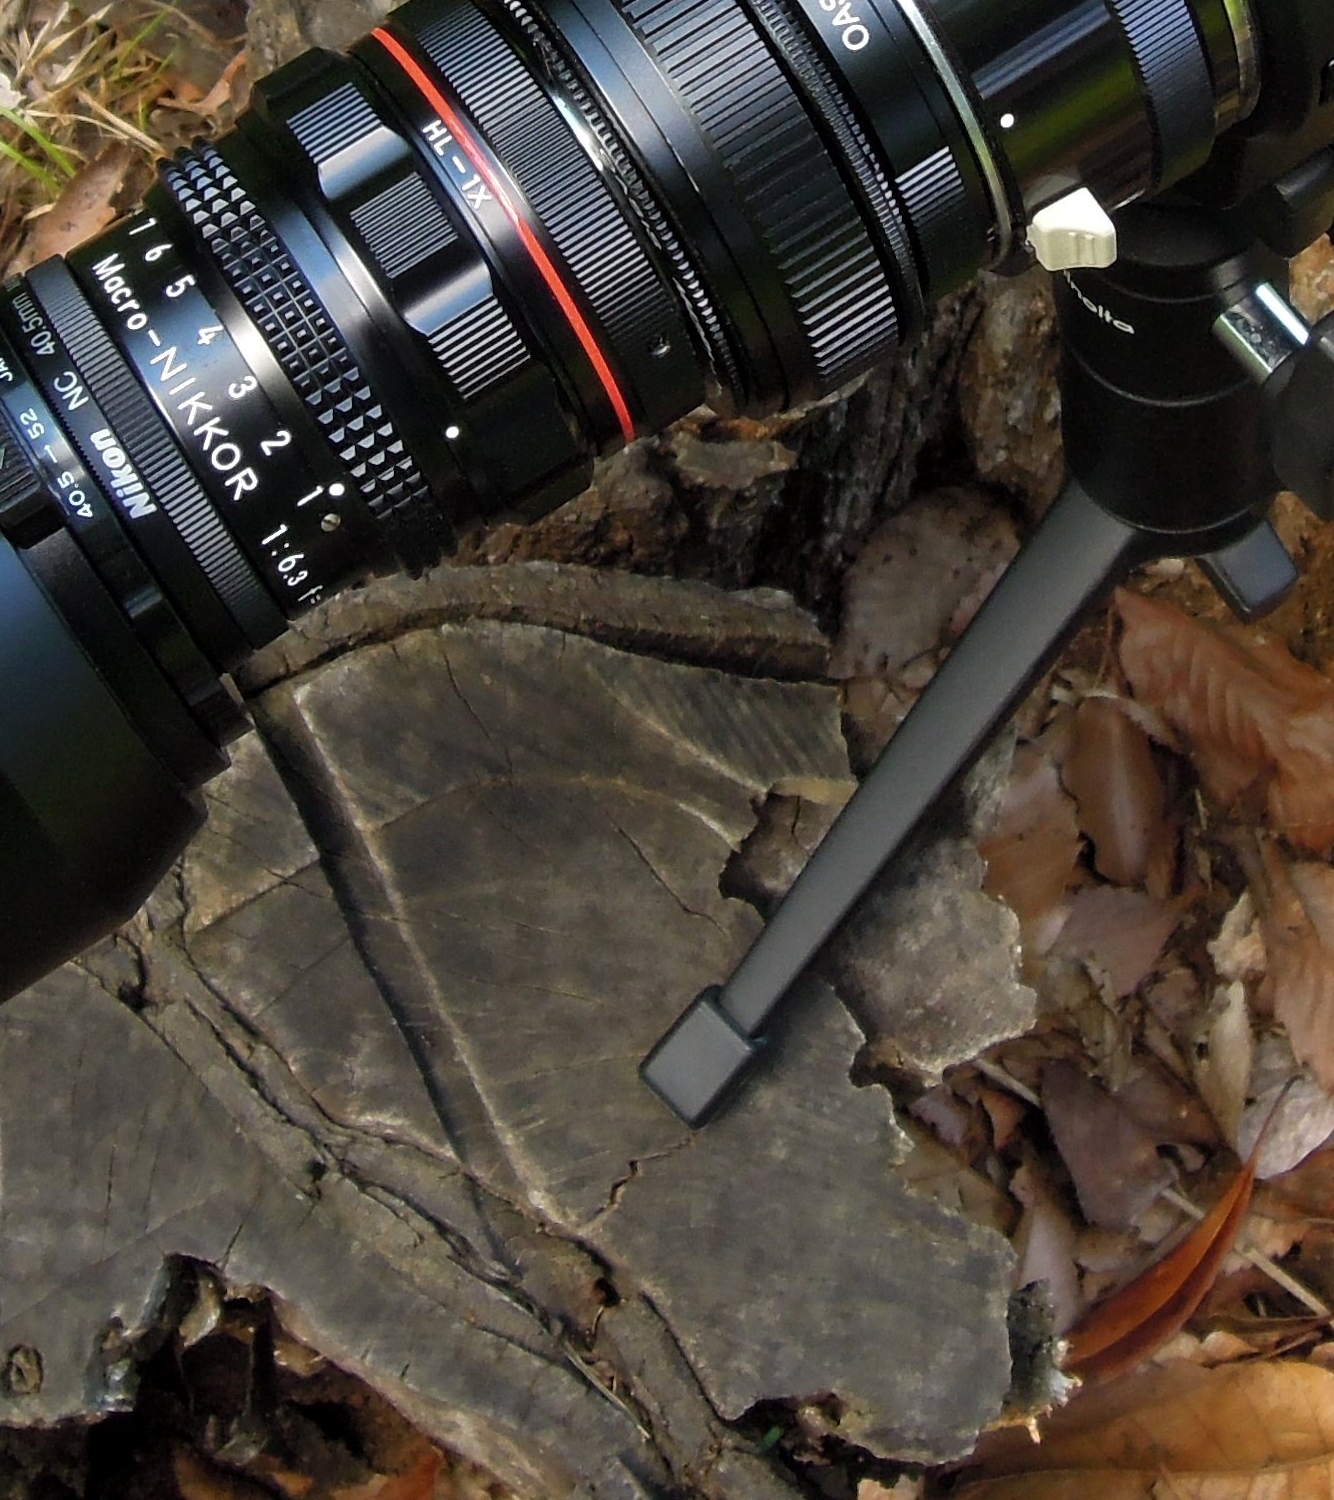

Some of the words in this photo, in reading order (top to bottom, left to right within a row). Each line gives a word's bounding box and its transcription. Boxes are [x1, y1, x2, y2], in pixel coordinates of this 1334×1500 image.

[12, 291, 57, 357] 40.5mm
[53, 370, 89, 412] NC
[145, 244, 174, 262] 6
[165, 274, 197, 298] 5
[196, 323, 224, 347] 4
[228, 375, 257, 399] 3
[260, 430, 292, 456] 2
[297, 484, 324, 507] 1
[20, 408, 45, 440] 52
[92, 252, 259, 501] Macro-NIKKOR
[261, 523, 308, 587] 1:6.3
[57, 470, 94, 519] 40.5
[90, 428, 158, 520] Nikon
